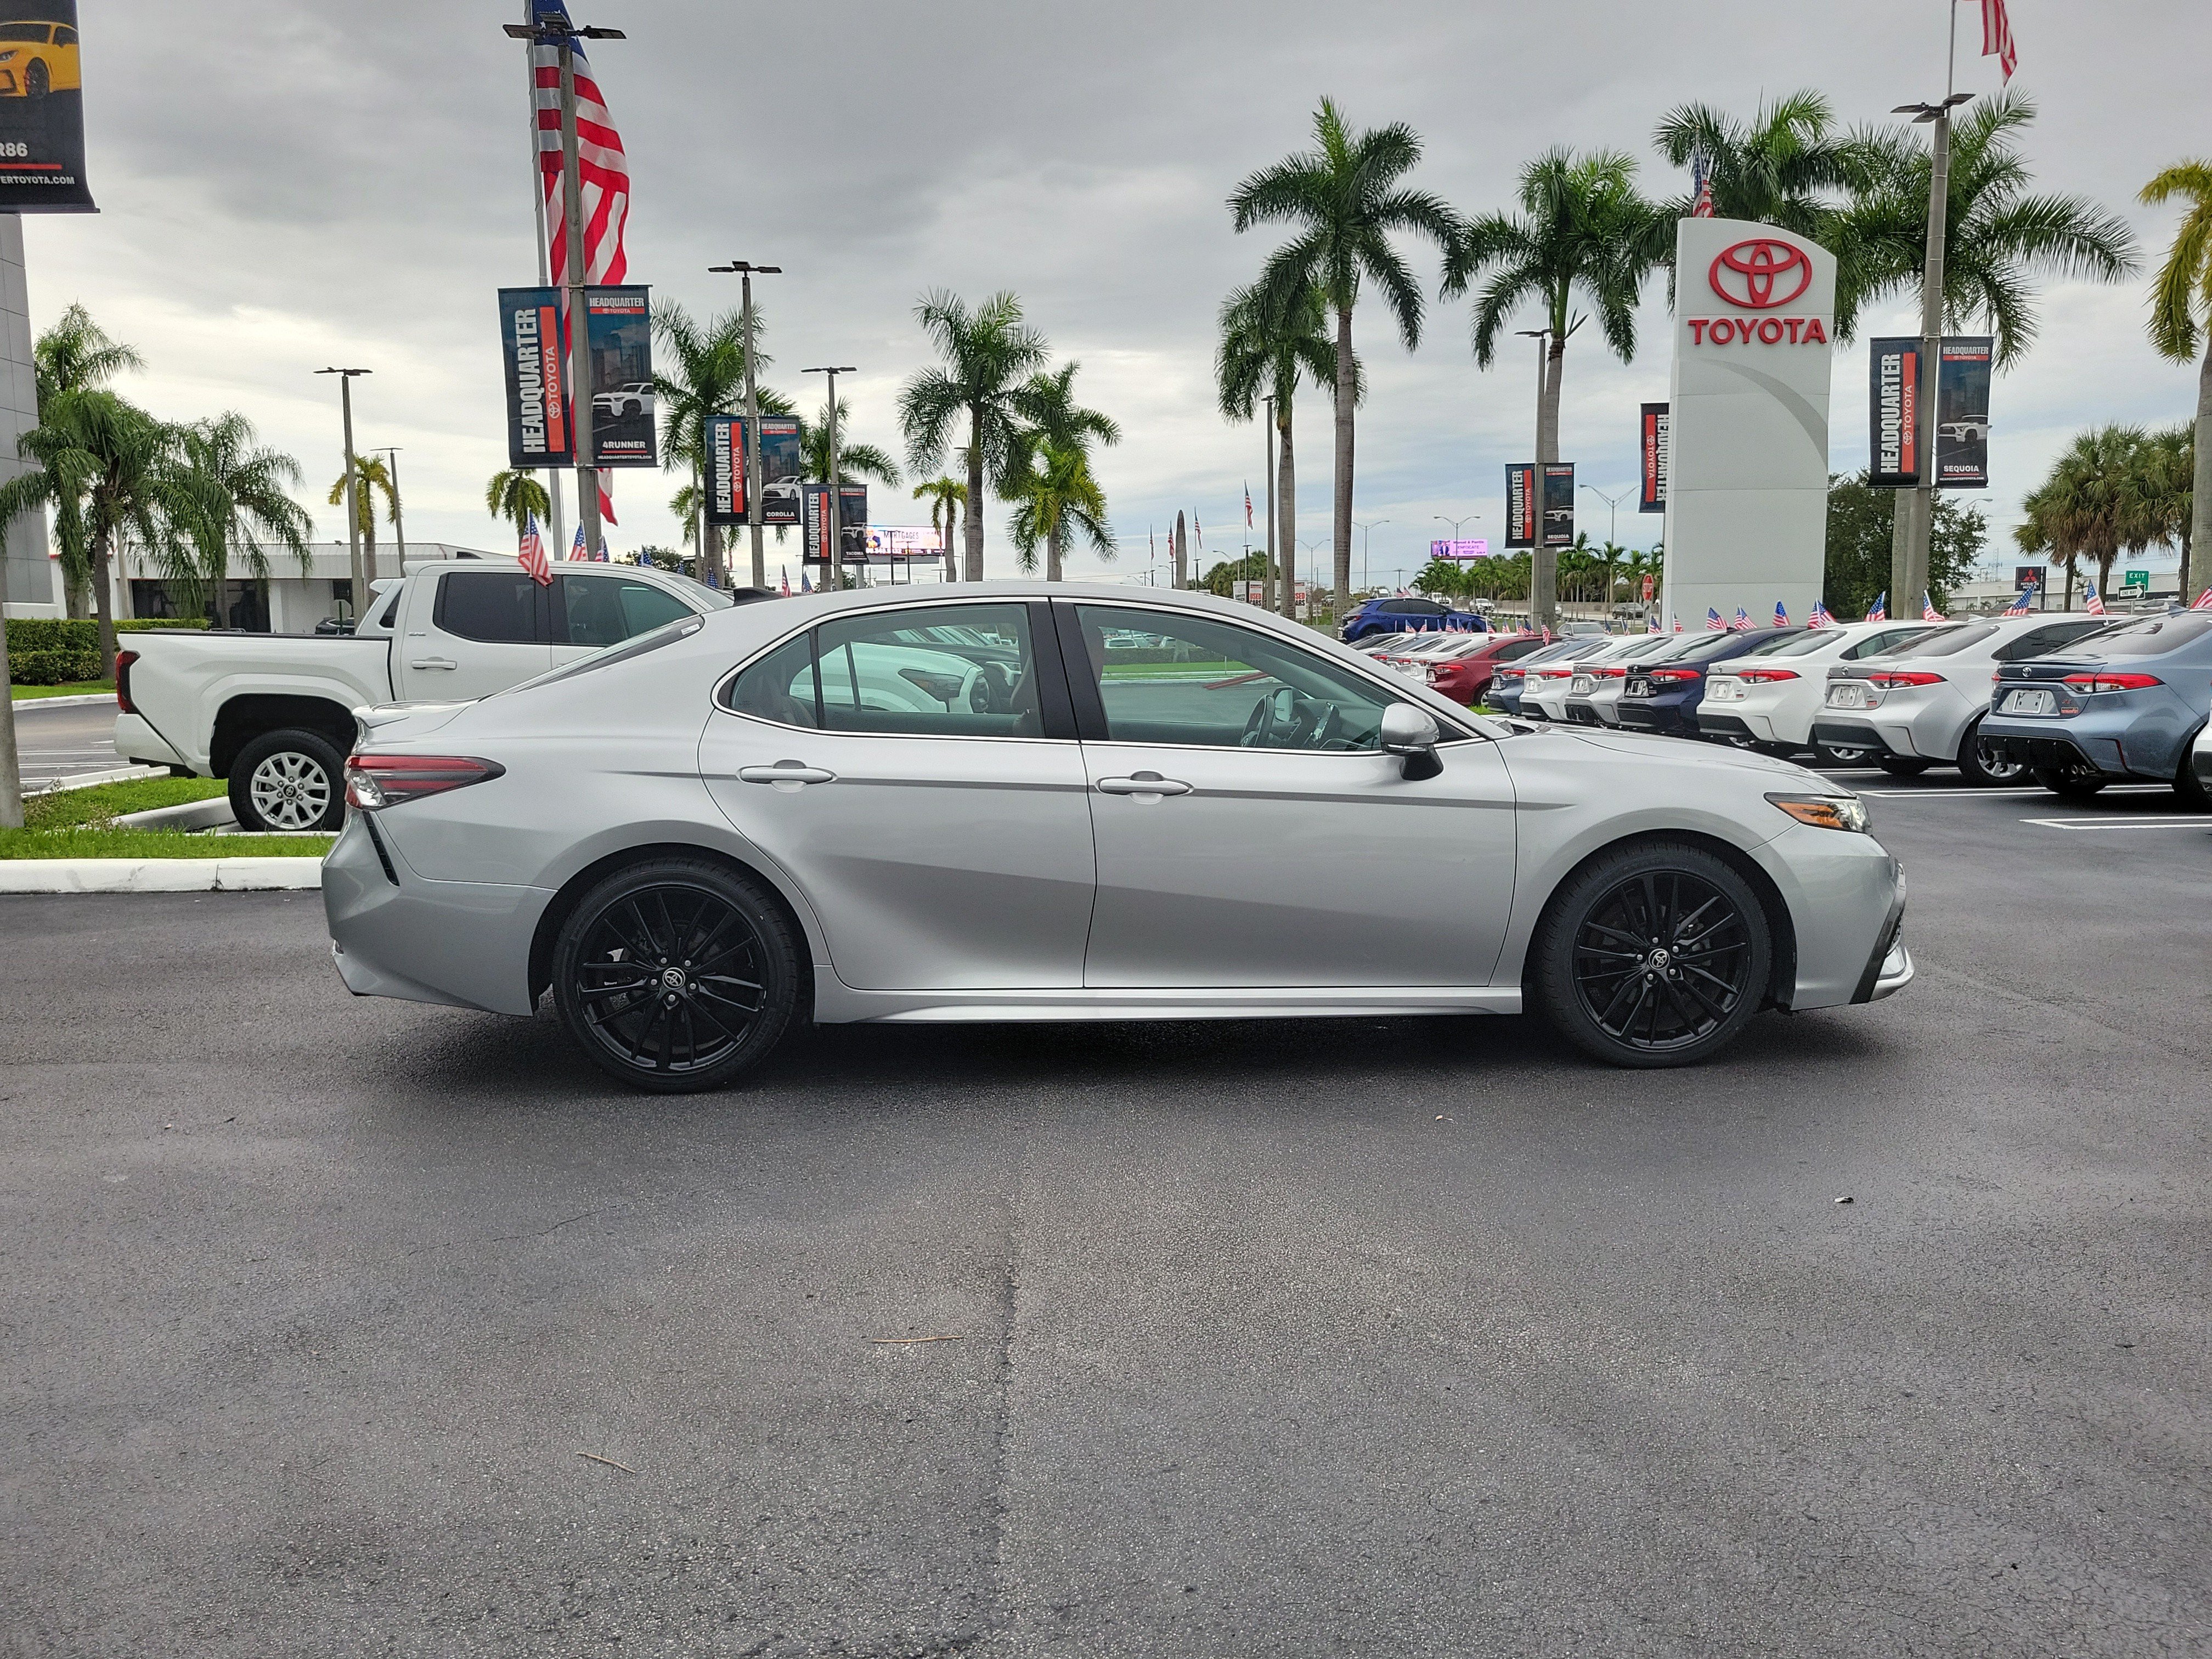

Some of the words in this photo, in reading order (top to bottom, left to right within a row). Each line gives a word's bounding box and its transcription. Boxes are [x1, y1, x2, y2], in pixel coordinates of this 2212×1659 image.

[0, 176, 75, 184] ERTOYOTA.COM
[590, 297, 645, 307] HEADQUARTER
[1688, 318, 1827, 345] TOYOTA
[1943, 347, 1989, 355] HEADQUARTER
[515, 308, 546, 453] HEADQUARTER
[547, 346, 559, 401] TOYOTA
[1880, 354, 1902, 473] HEADQUARTER
[1904, 385, 1912, 430] TOYOTA
[715, 423, 732, 513] HEADQUARTER
[809, 493, 821, 557] HEADQUARTER
[1512, 470, 1525, 539] HEADQUARTER
[884, 531, 919, 539] MRTGAGES
